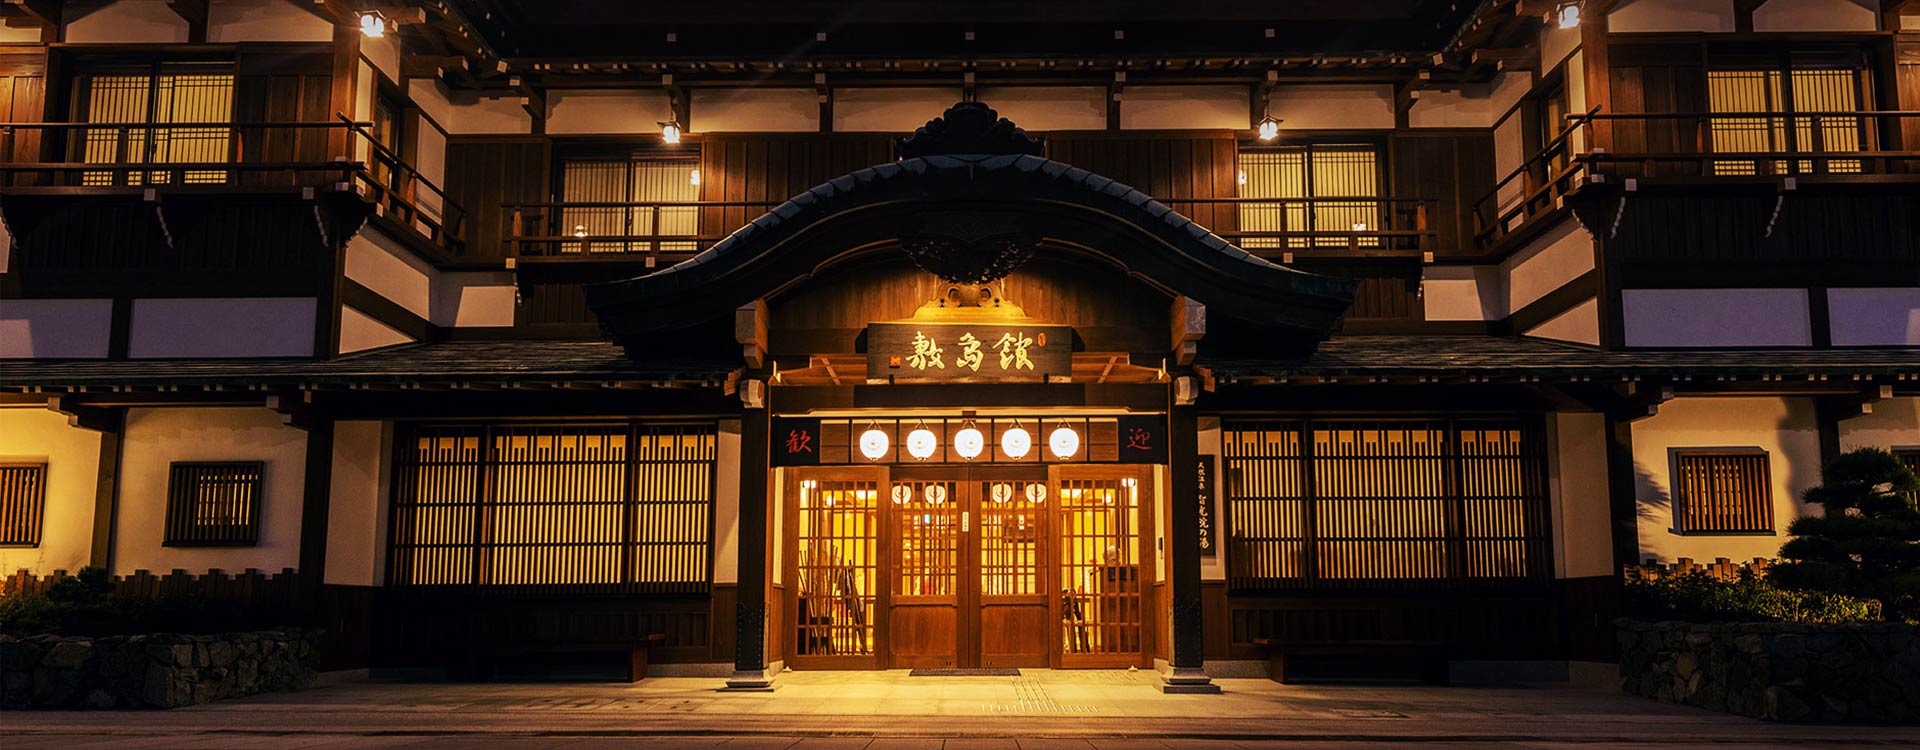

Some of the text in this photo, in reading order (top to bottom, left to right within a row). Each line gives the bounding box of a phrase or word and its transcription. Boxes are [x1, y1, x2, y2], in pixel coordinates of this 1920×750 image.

[906, 331, 1035, 372] 敷島館
[1127, 427, 1152, 450] 迎
